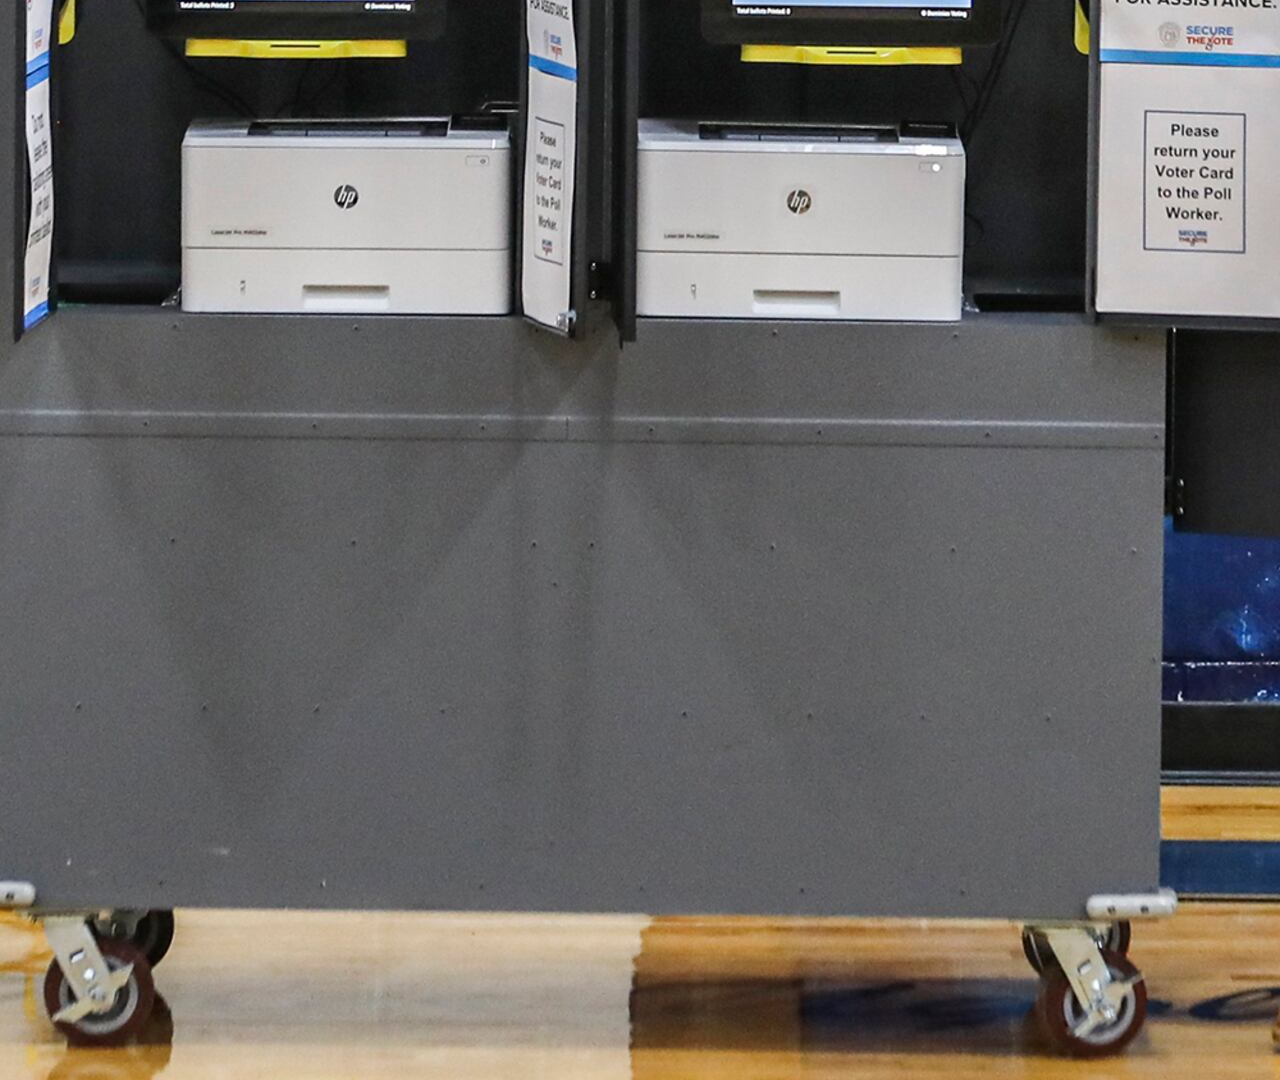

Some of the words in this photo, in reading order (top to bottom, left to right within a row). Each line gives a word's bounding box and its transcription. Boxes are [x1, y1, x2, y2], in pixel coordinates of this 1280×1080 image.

[1186, 26, 1233, 35] SECURE
[1170, 123, 1219, 137] Please
[1153, 146, 1198, 157] return
[1202, 148, 1236, 161] your
[1154, 165, 1195, 178] Voter
[1198, 166, 1234, 179] Card
[1157, 186, 1172, 198] to
[1176, 186, 1199, 199] the
[1203, 186, 1231, 200] Poll
[1165, 206, 1223, 220] Worker.
